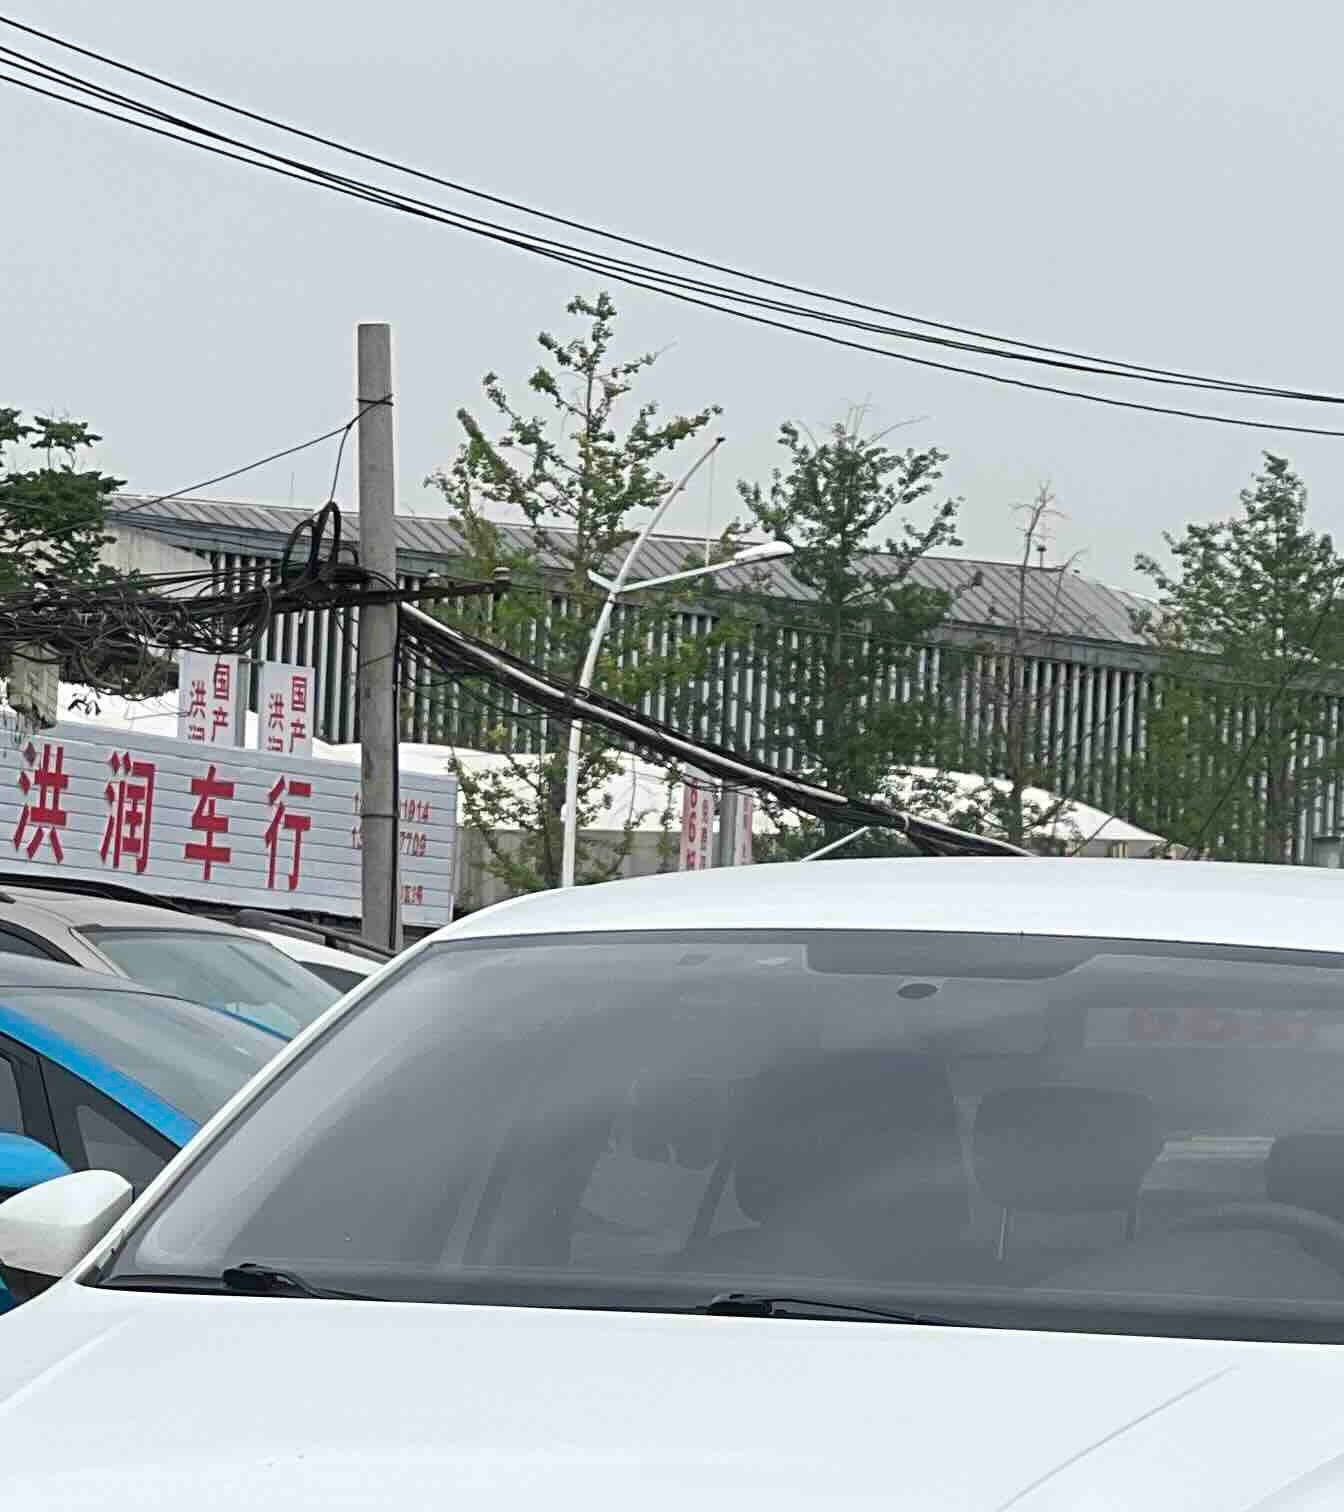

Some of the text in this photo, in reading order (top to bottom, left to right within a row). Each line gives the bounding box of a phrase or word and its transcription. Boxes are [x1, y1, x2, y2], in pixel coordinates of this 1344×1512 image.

[212, 663, 230, 742] 国产
[289, 675, 307, 753] 国产
[12, 741, 312, 891] 洪润车行
